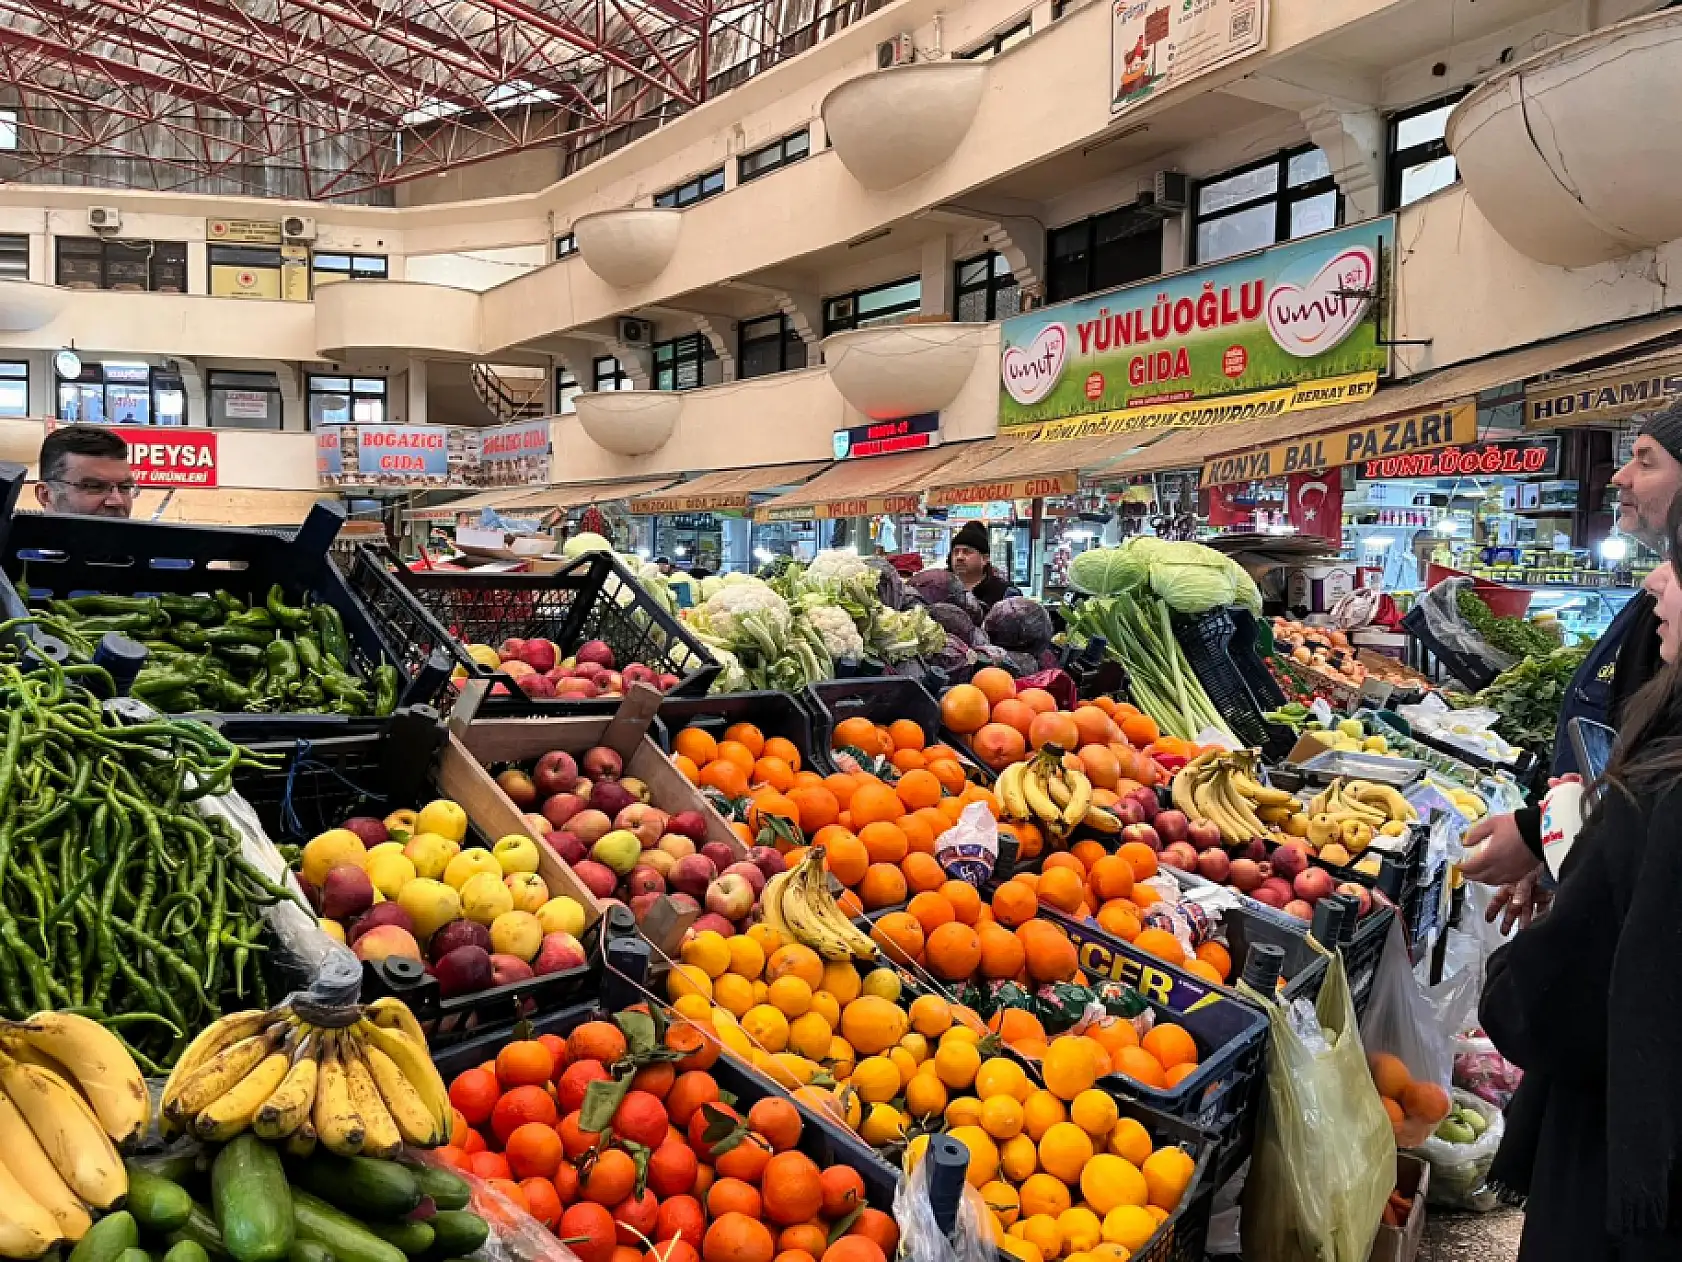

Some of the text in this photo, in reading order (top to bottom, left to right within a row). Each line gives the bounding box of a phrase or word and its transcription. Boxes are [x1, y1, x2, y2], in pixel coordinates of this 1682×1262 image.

[1076, 278, 1265, 354] YÜNLÜOĞLU
[1128, 347, 1191, 387] GIDA
[1180, 399, 1285, 425] SHOWROOM
[380, 454, 425, 472] GIDA
[1207, 451, 1271, 484] KONYA
[1284, 440, 1326, 471] BAL
[1024, 477, 1061, 496] GIDA
